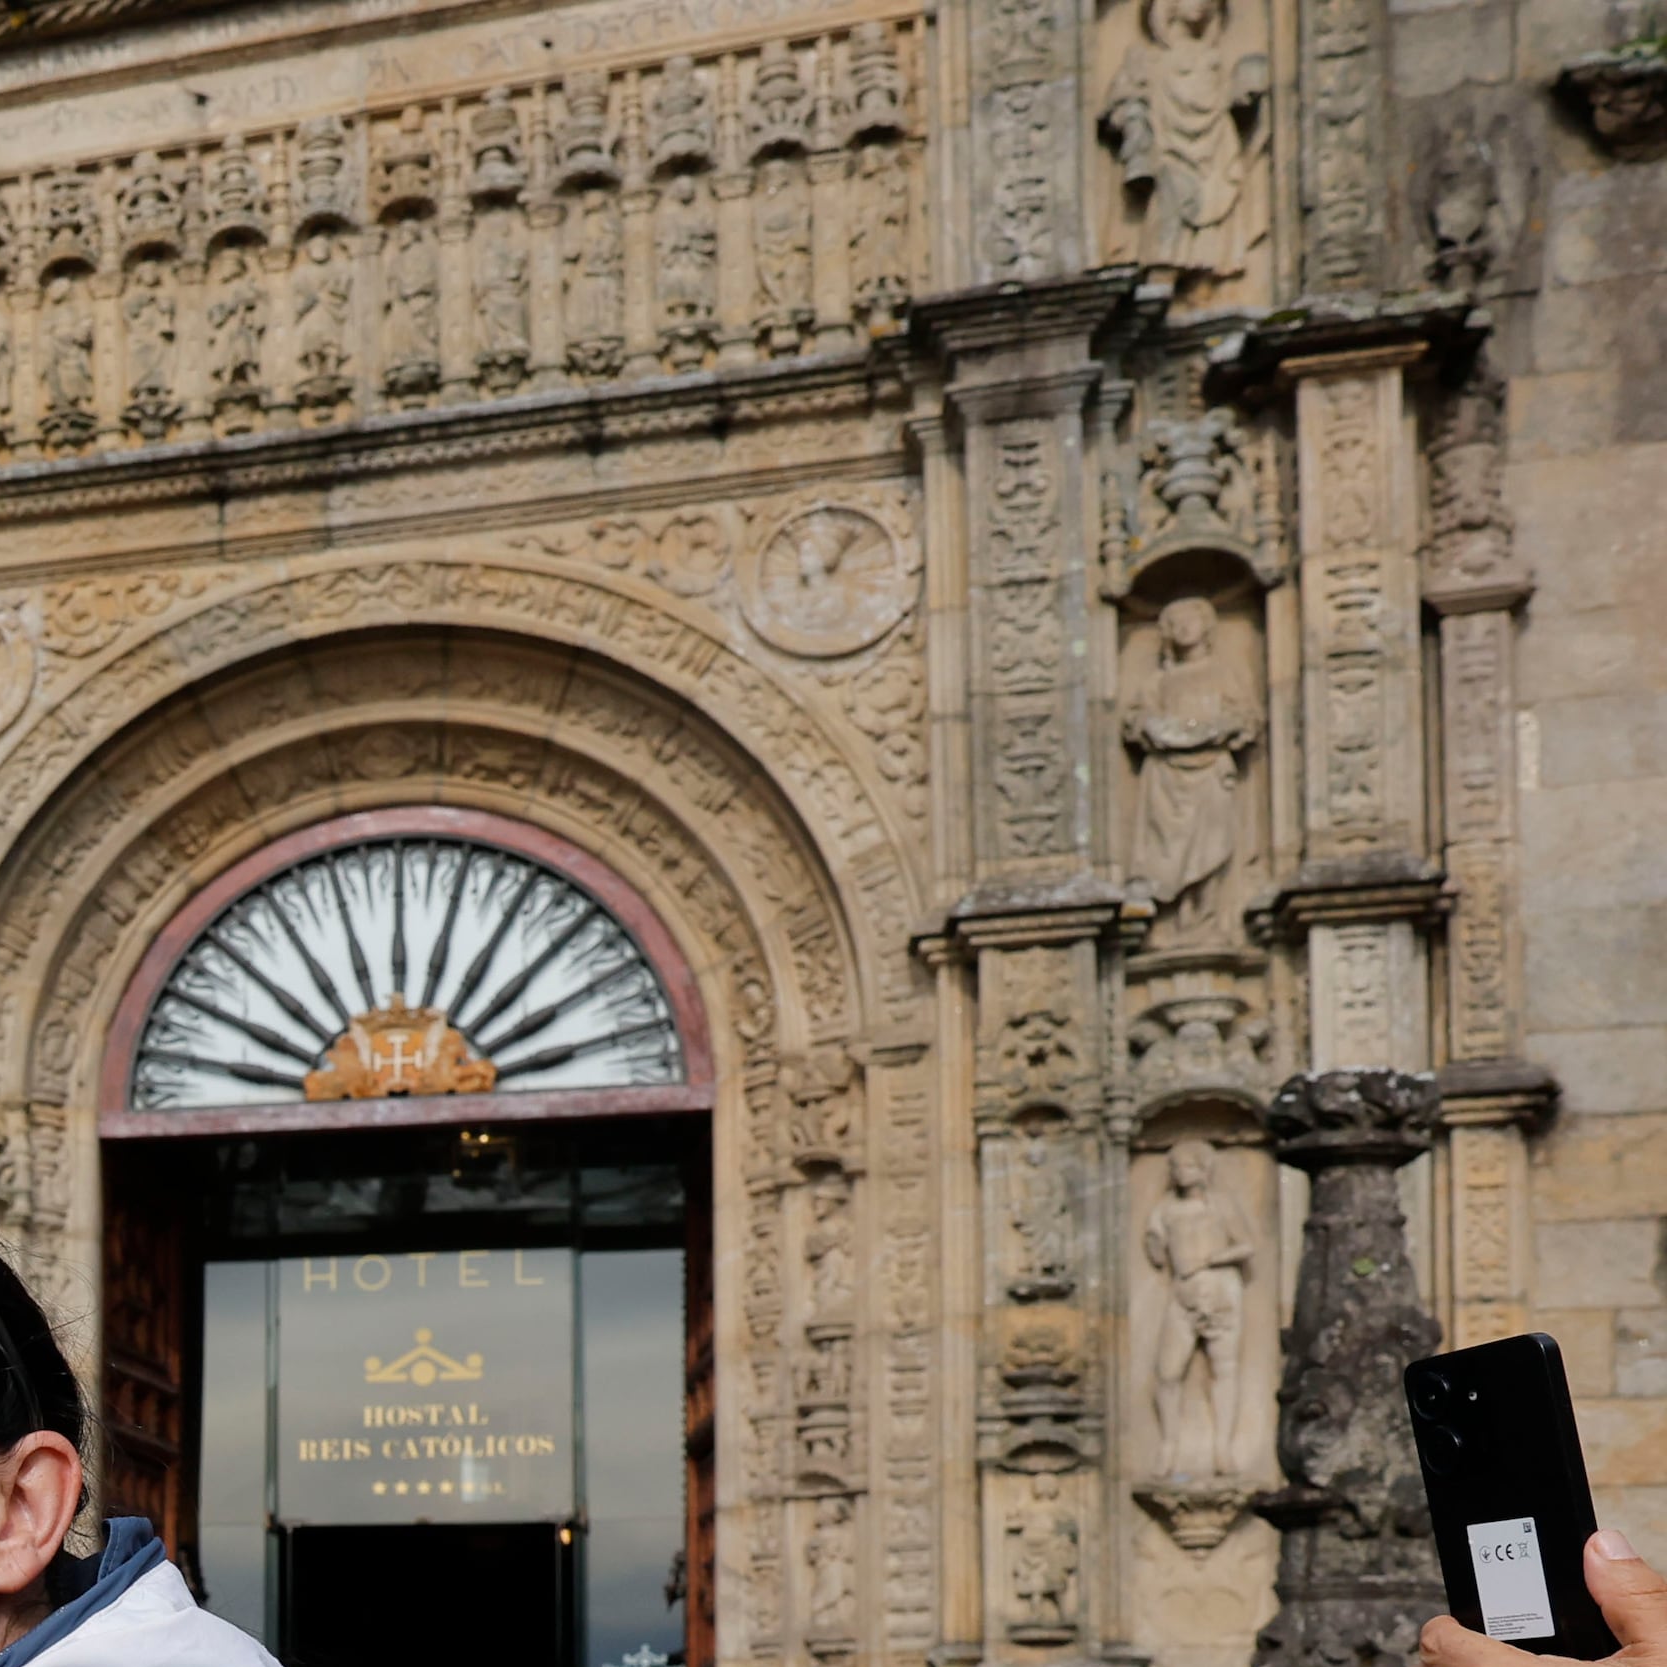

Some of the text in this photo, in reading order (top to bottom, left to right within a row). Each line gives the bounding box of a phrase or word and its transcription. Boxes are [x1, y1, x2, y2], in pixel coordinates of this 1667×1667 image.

[303, 1249, 545, 1292] HOTEL
[363, 1403, 490, 1428] HOSTAL
[298, 1432, 556, 1462] REIS CATÓLICOS
